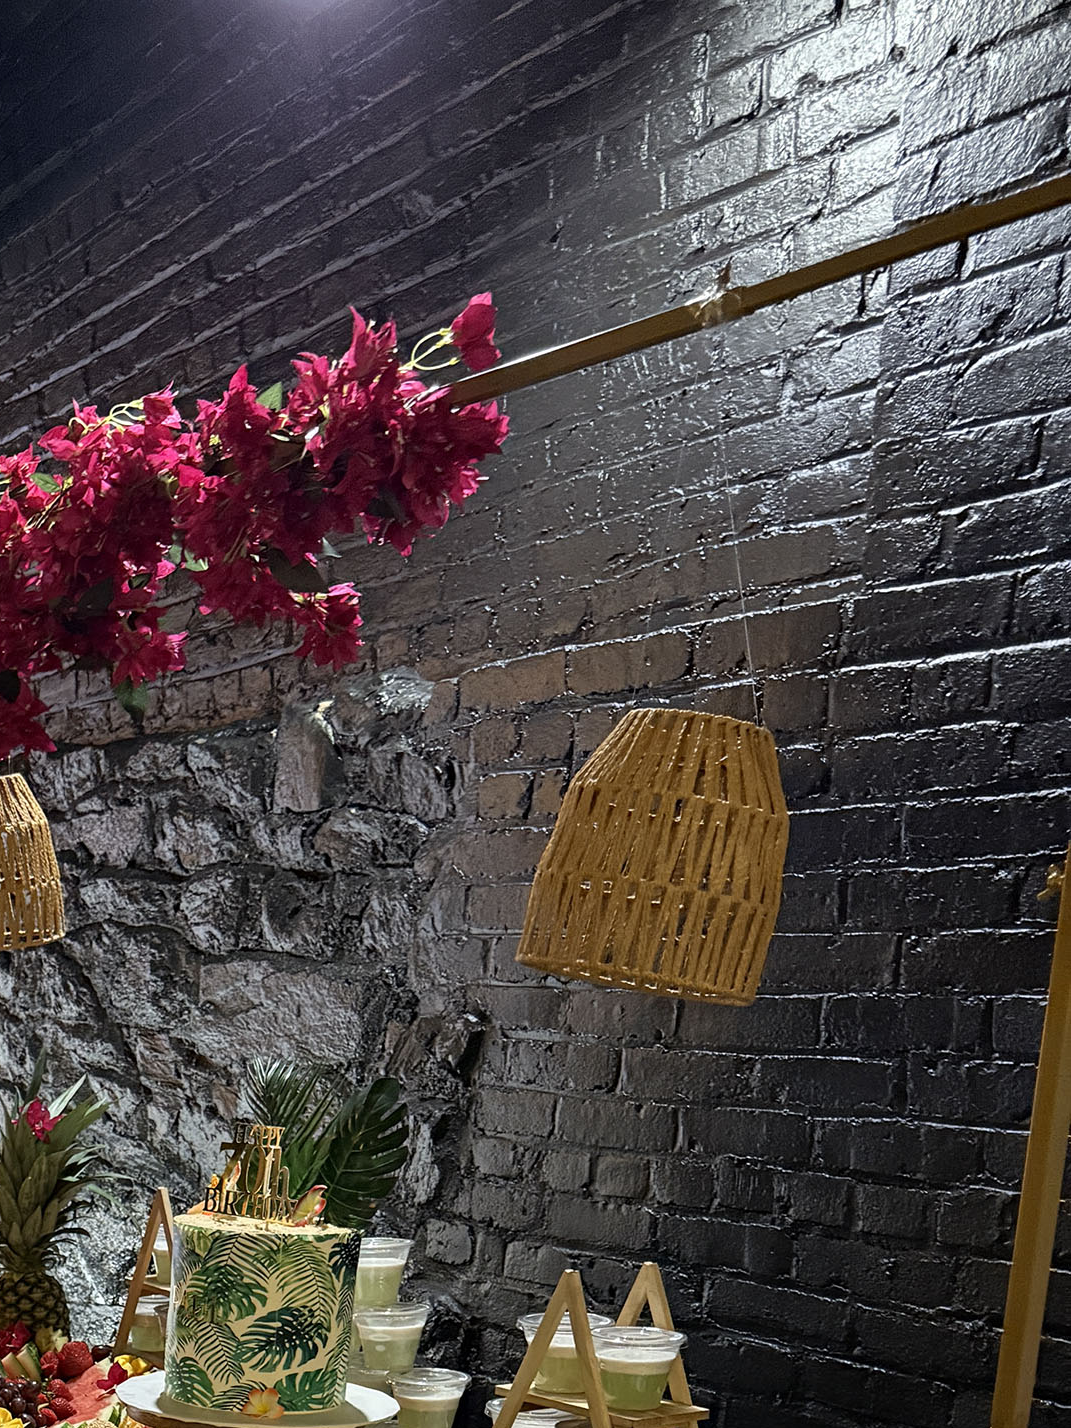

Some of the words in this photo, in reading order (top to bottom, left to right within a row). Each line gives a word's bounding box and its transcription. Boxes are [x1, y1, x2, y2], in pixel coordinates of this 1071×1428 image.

[233, 1122, 285, 1147] HAPPY
[219, 1141, 290, 1199] 70th
[203, 1186, 298, 1222] BIRTHDAY
